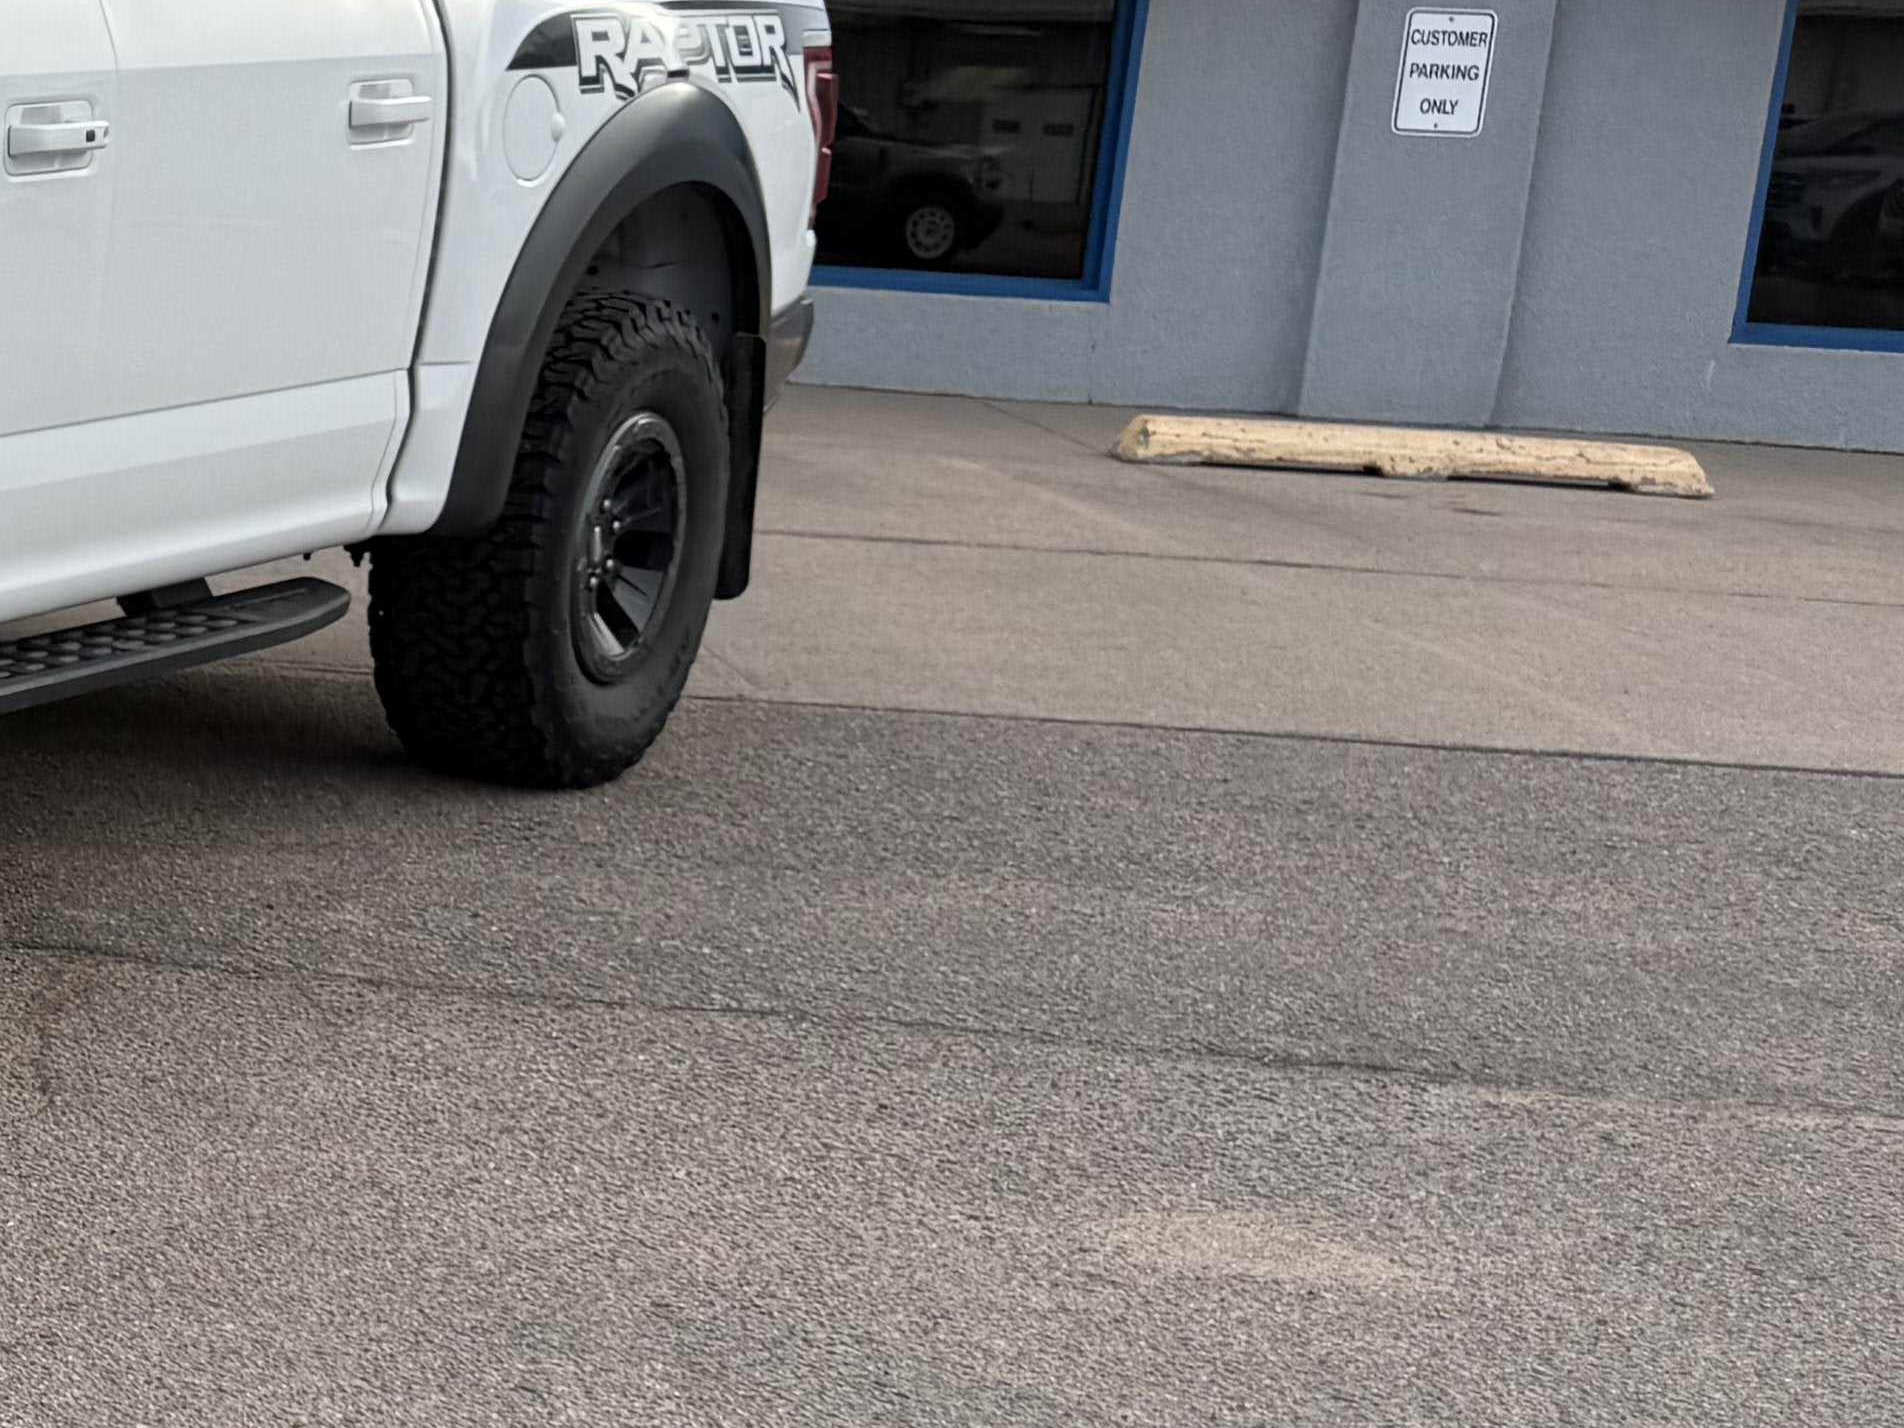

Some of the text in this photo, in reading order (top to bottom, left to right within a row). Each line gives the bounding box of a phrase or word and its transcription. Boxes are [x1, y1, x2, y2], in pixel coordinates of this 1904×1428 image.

[1410, 29, 1488, 48] CUSTOMER
[570, 13, 802, 113] RAPTOR
[1409, 62, 1480, 81] PARKING
[1419, 98, 1459, 115] ONLY
